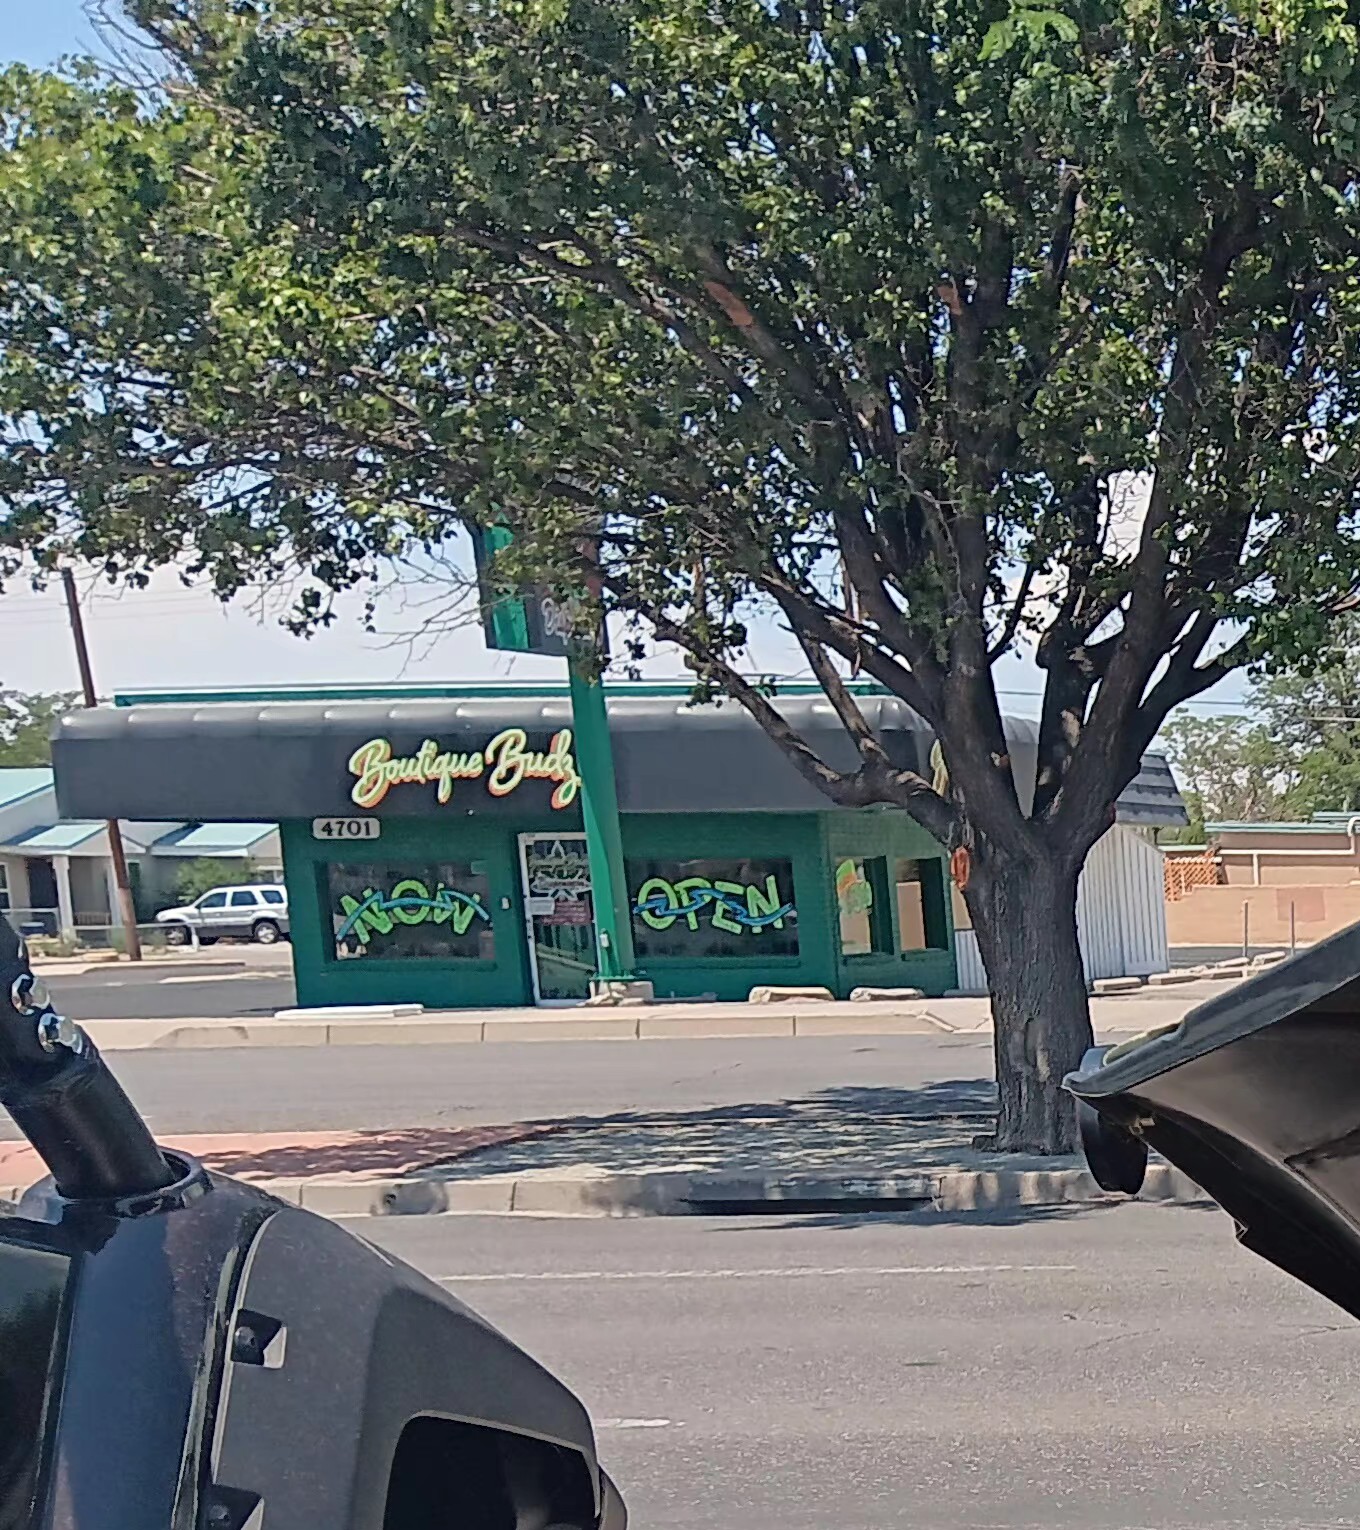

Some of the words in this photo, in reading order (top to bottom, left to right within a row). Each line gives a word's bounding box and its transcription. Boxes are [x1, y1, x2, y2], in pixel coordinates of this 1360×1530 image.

[349, 738, 484, 808] Boutique
[486, 728, 582, 809] Budz
[320, 820, 372, 837] 4701
[338, 879, 481, 943] NOW
[636, 875, 787, 934] OPEN
